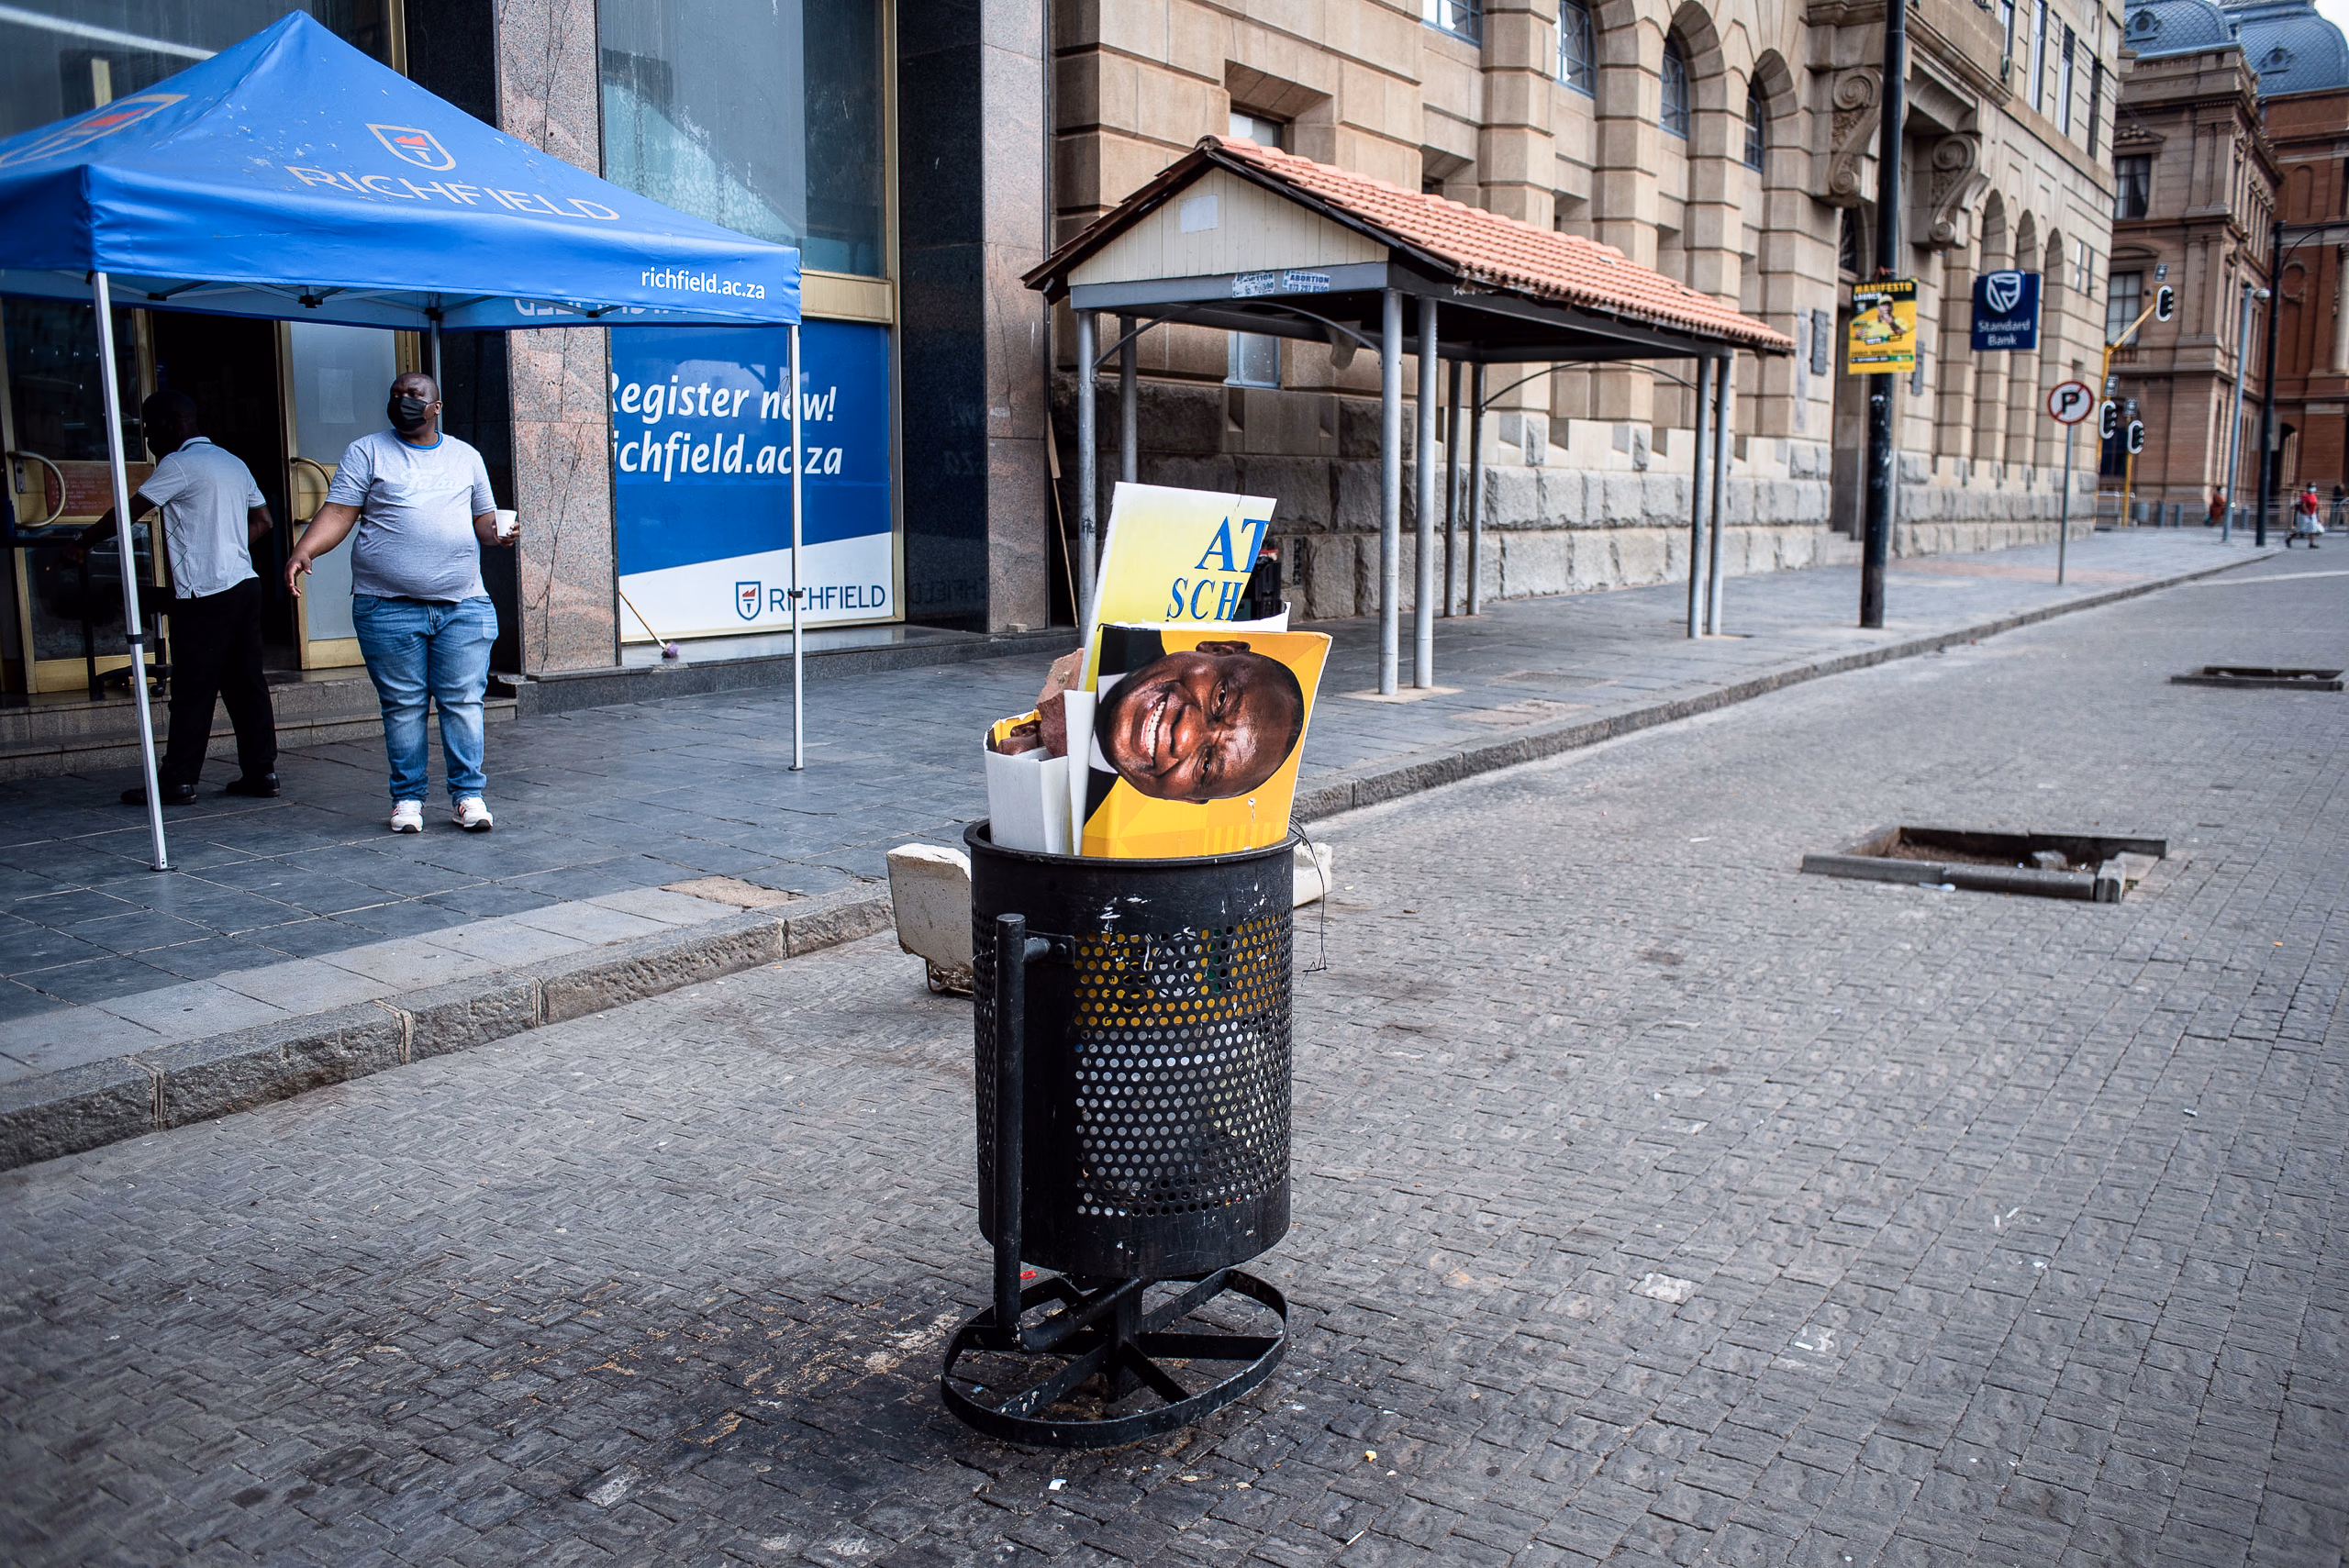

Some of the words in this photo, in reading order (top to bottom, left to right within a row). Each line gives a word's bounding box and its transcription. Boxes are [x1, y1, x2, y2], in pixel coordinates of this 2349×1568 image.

[284, 165, 620, 221] RICHFIELD
[641, 266, 765, 300] richfield.ac.za
[1290, 274, 1330, 284] ABORTION
[1854, 282, 1913, 294] MANIFESTO
[1977, 317, 2031, 332] Standard
[1987, 333, 2017, 346] Bank
[2062, 392, 2080, 415] P
[614, 430, 843, 483] ichfield.acza
[1195, 516, 1271, 573] AT
[770, 584, 885, 612] RIHFIELD
[1166, 577, 1243, 621] SCH
